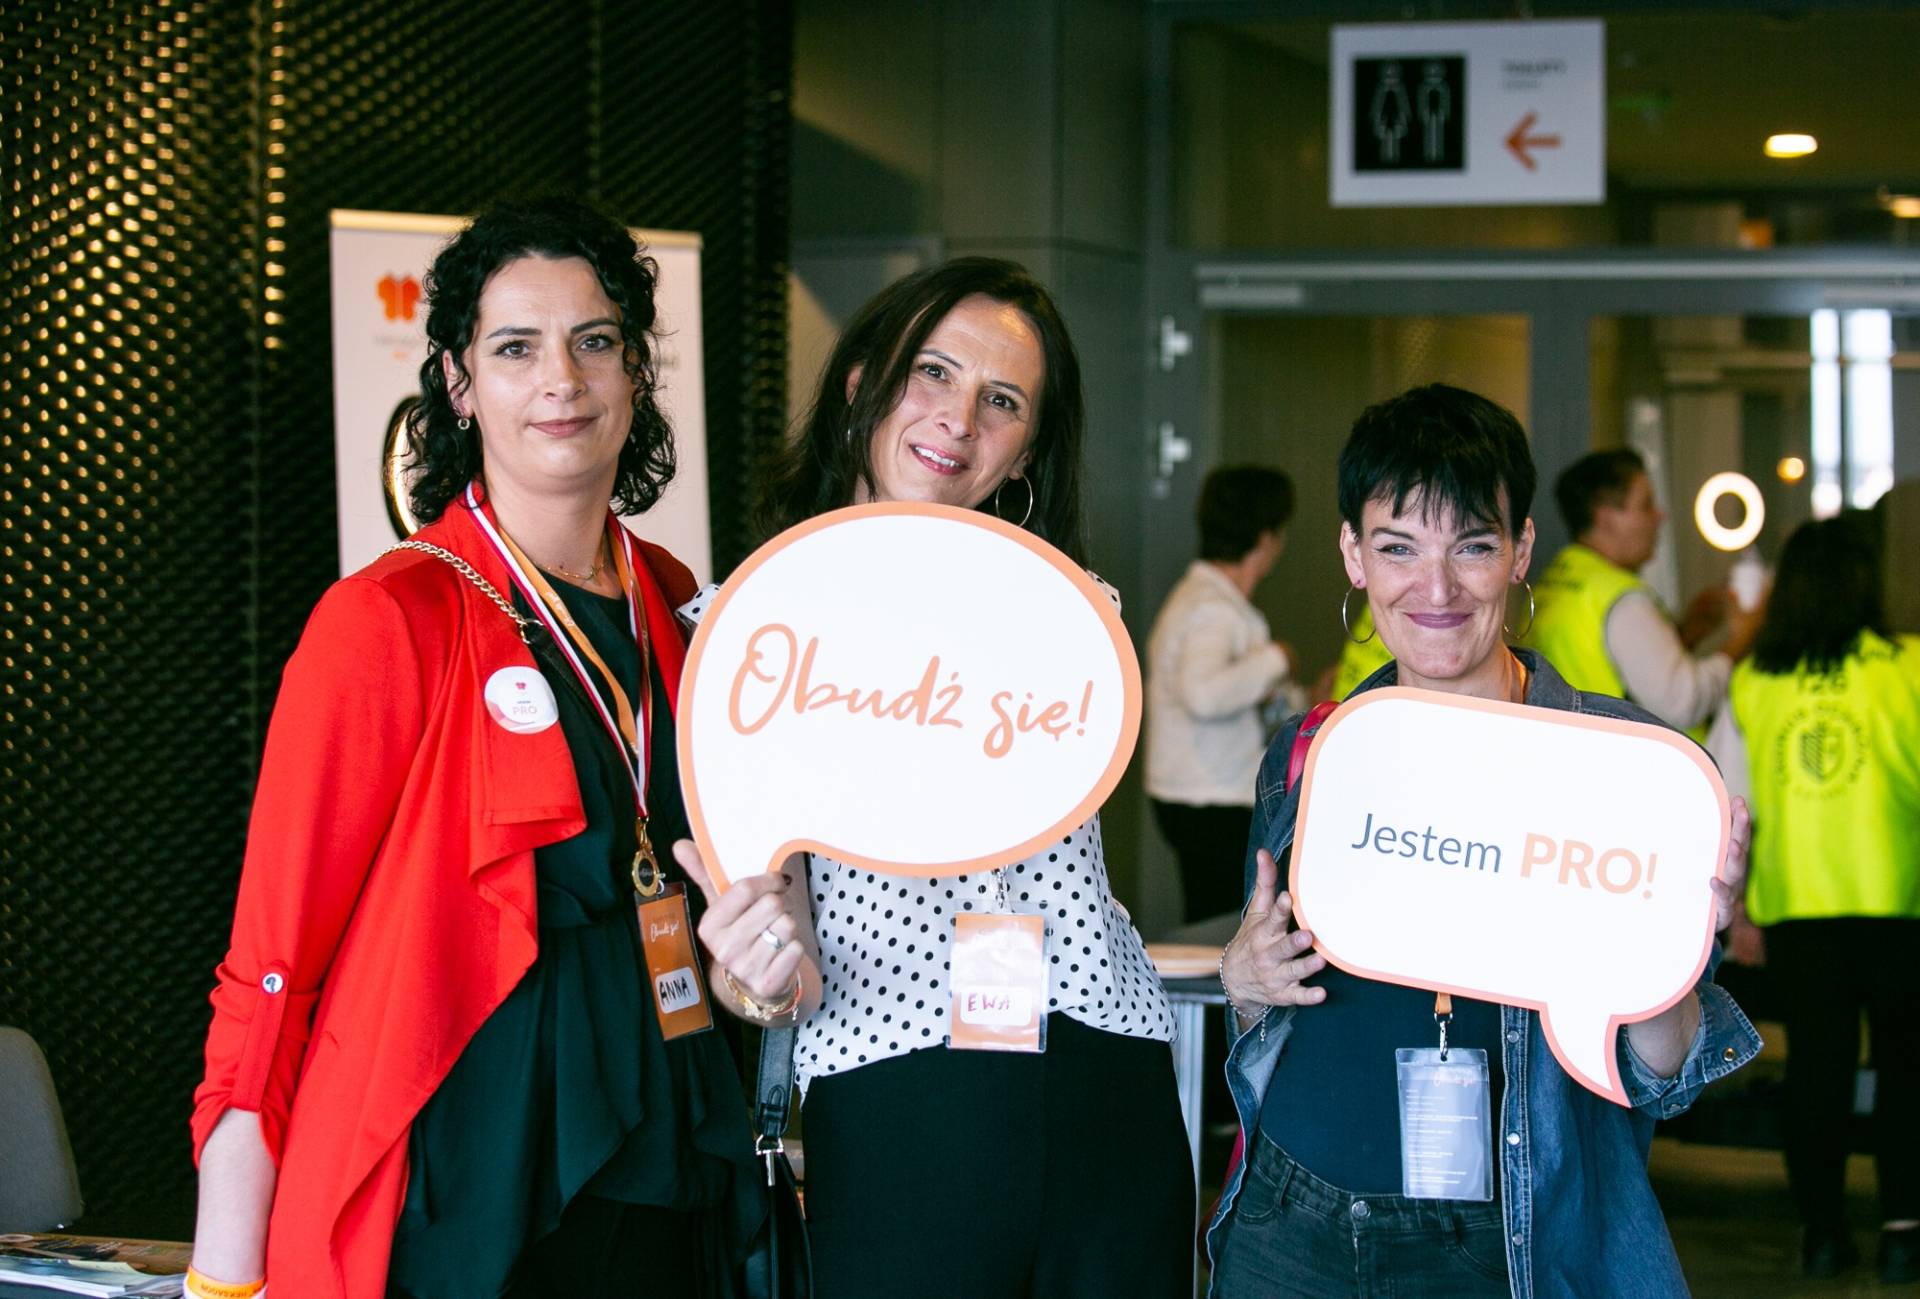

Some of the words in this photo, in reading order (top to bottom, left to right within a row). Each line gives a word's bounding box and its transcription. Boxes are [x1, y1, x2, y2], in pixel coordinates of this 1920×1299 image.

[729, 623, 963, 735] Obudź
[983, 680, 1093, 758] się!
[512, 705, 538, 715] PRO
[1351, 813, 1501, 873] Jestem
[1521, 833, 1657, 899] PRO!
[659, 976, 690, 1005] ANNA
[967, 993, 1010, 1012] EWA
